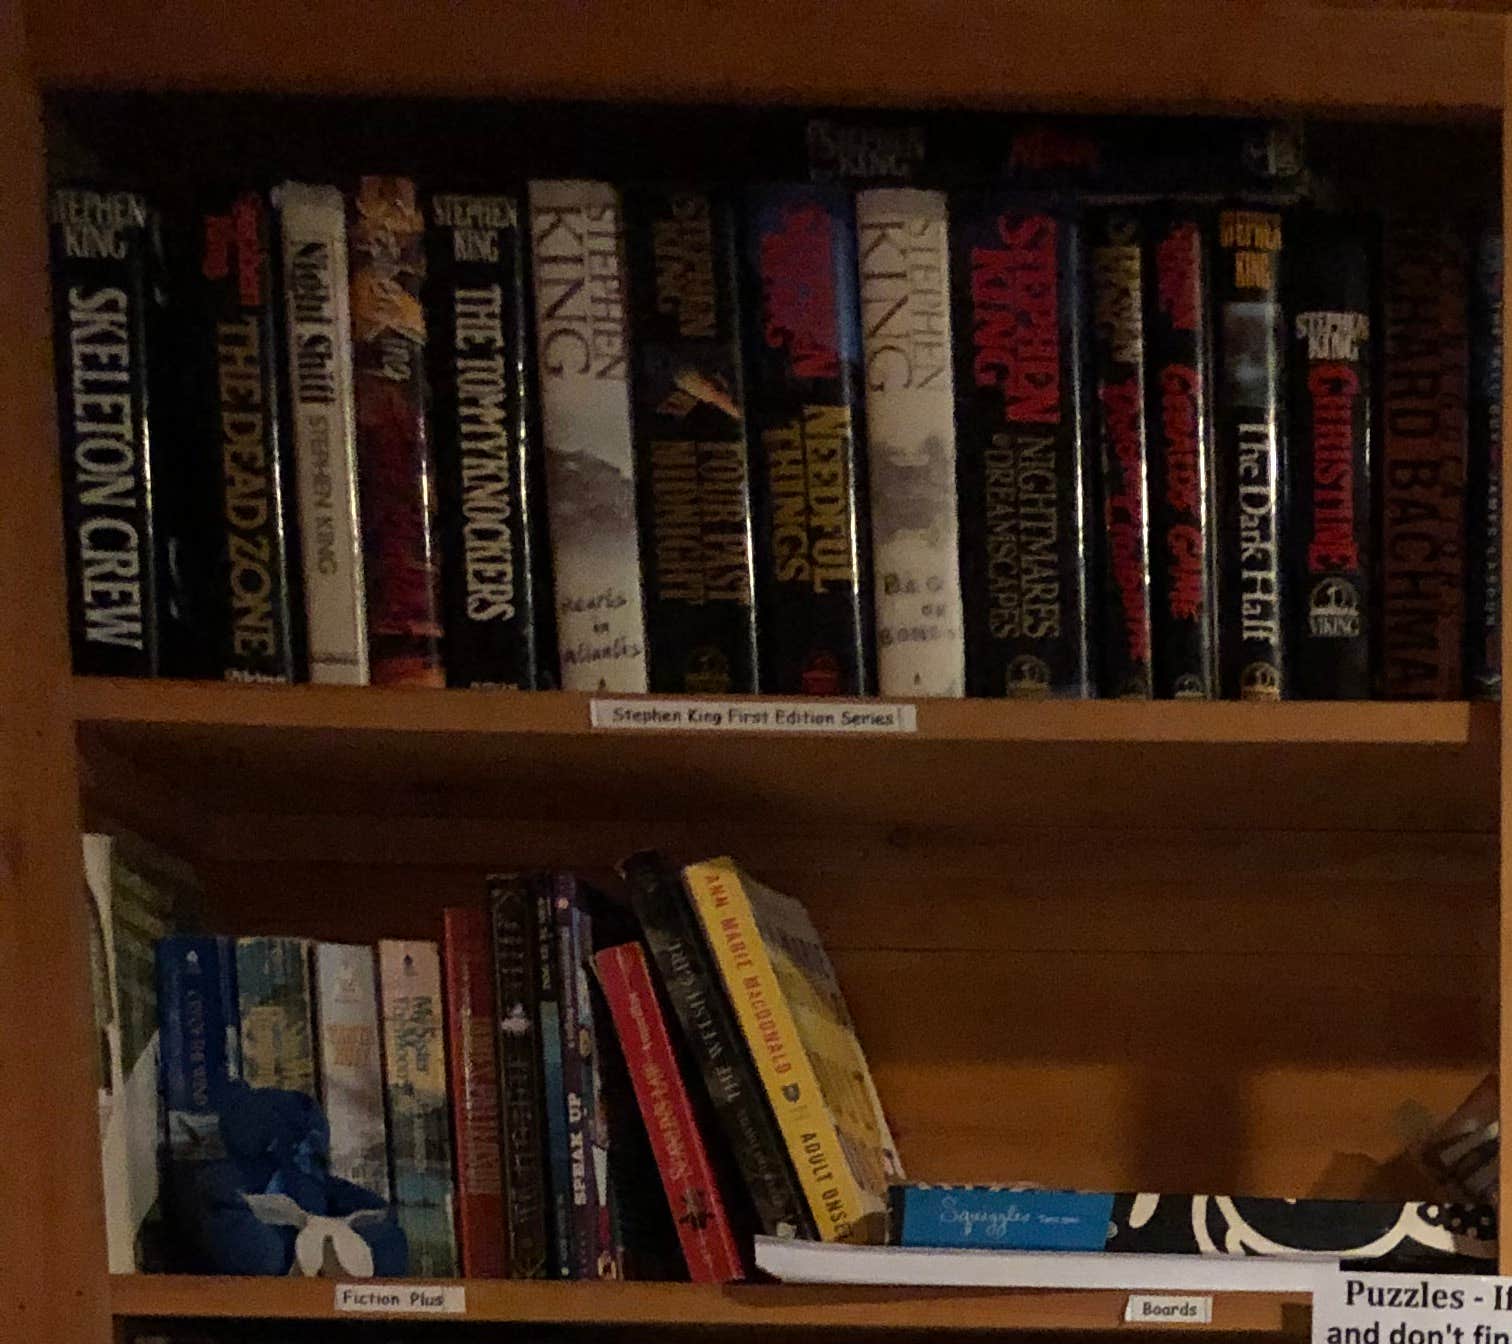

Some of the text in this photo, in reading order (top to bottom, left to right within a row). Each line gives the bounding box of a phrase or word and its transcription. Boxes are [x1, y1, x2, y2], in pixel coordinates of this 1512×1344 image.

[531, 206, 591, 378] KING
[586, 202, 627, 381] STEPHEN
[864, 221, 914, 392] KING
[69, 285, 144, 652] SKELETON CREW
[223, 410, 275, 657] DEAD ZONE
[764, 420, 809, 583] THINGS
[803, 404, 855, 594] NEEDFUL
[1018, 434, 1062, 639] NIGHTMARES
[1306, 363, 1360, 572] CHRISTINE
[612, 706, 895, 728] Stephen King First Edition Series
[343, 1287, 445, 1308] Fiction Plus
[1141, 1300, 1199, 1320] Boards
[1345, 1280, 1466, 1311] Puzzles
